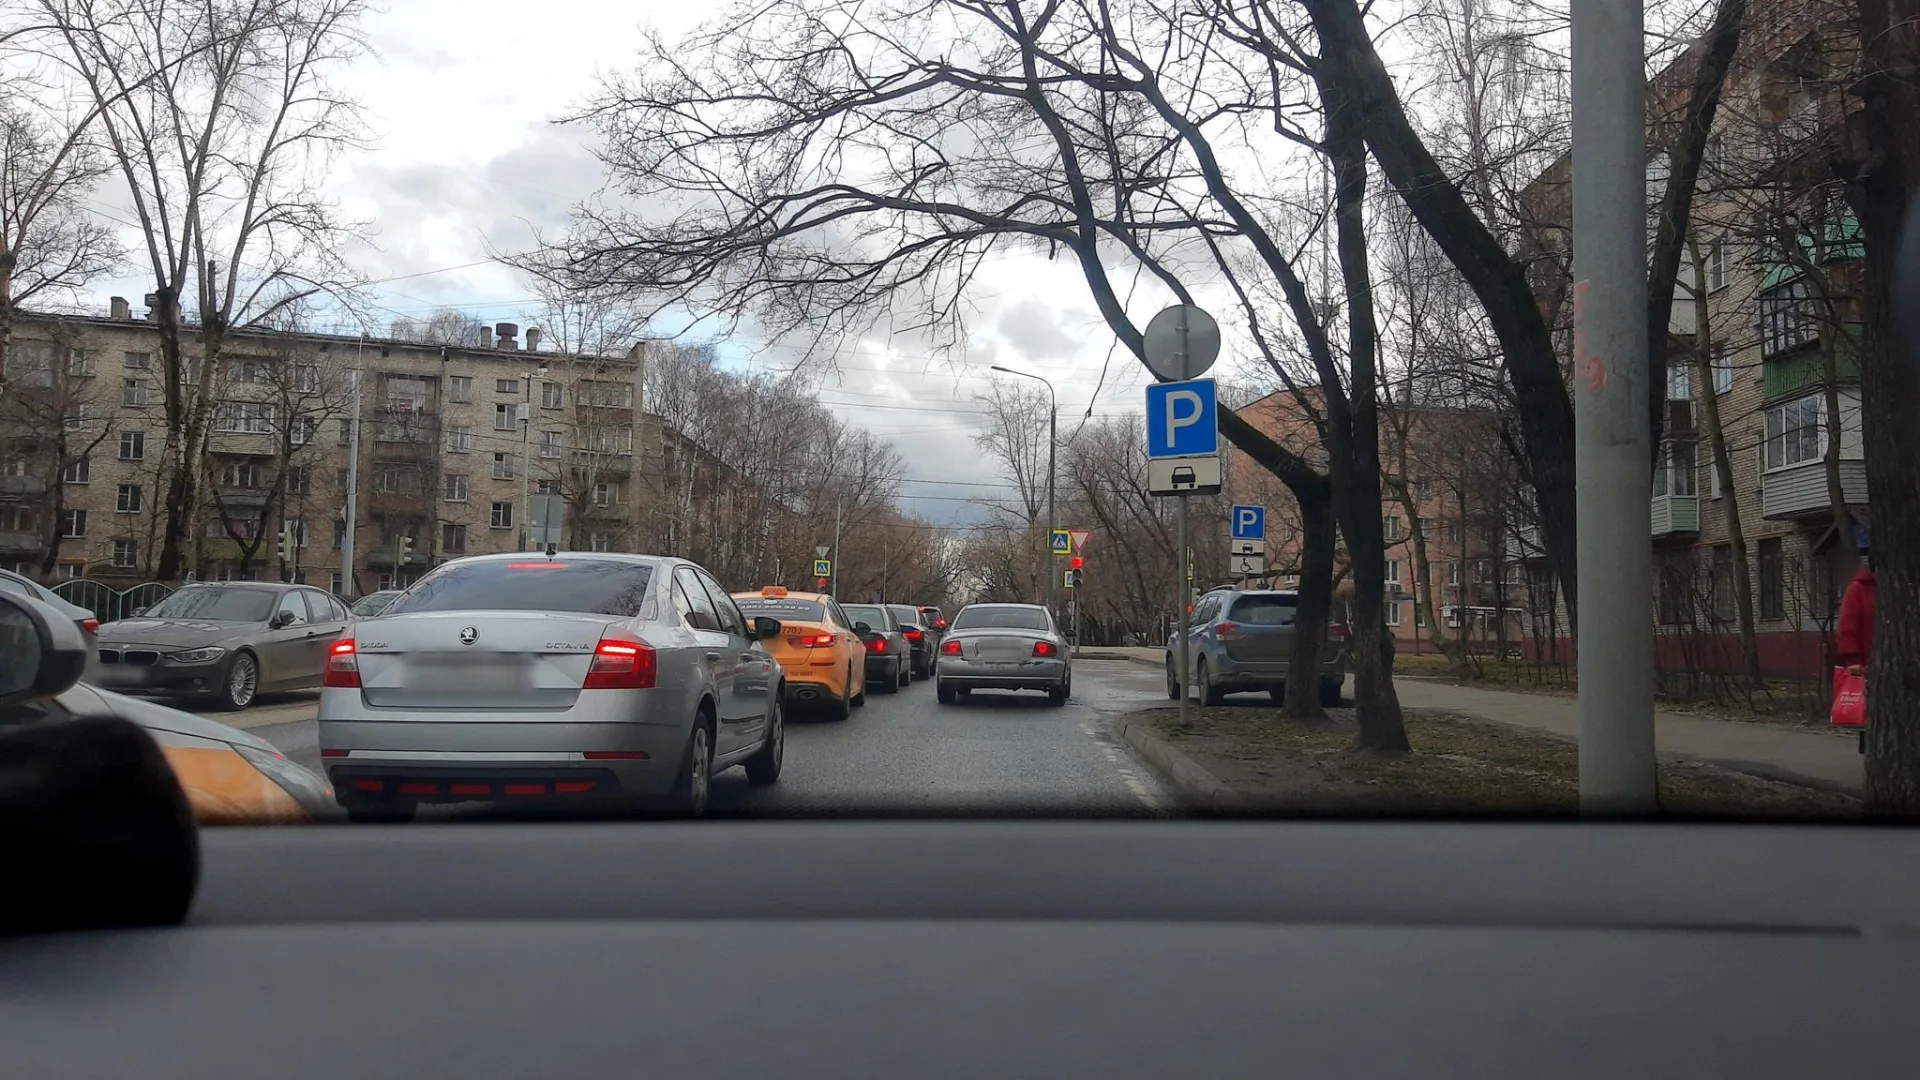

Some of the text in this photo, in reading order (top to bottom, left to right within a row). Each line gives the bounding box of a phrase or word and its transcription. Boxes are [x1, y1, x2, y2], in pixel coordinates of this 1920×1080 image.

[1165, 390, 1203, 448] P
[1238, 509, 1257, 535] P
[545, 642, 590, 650] OCTAVIA
